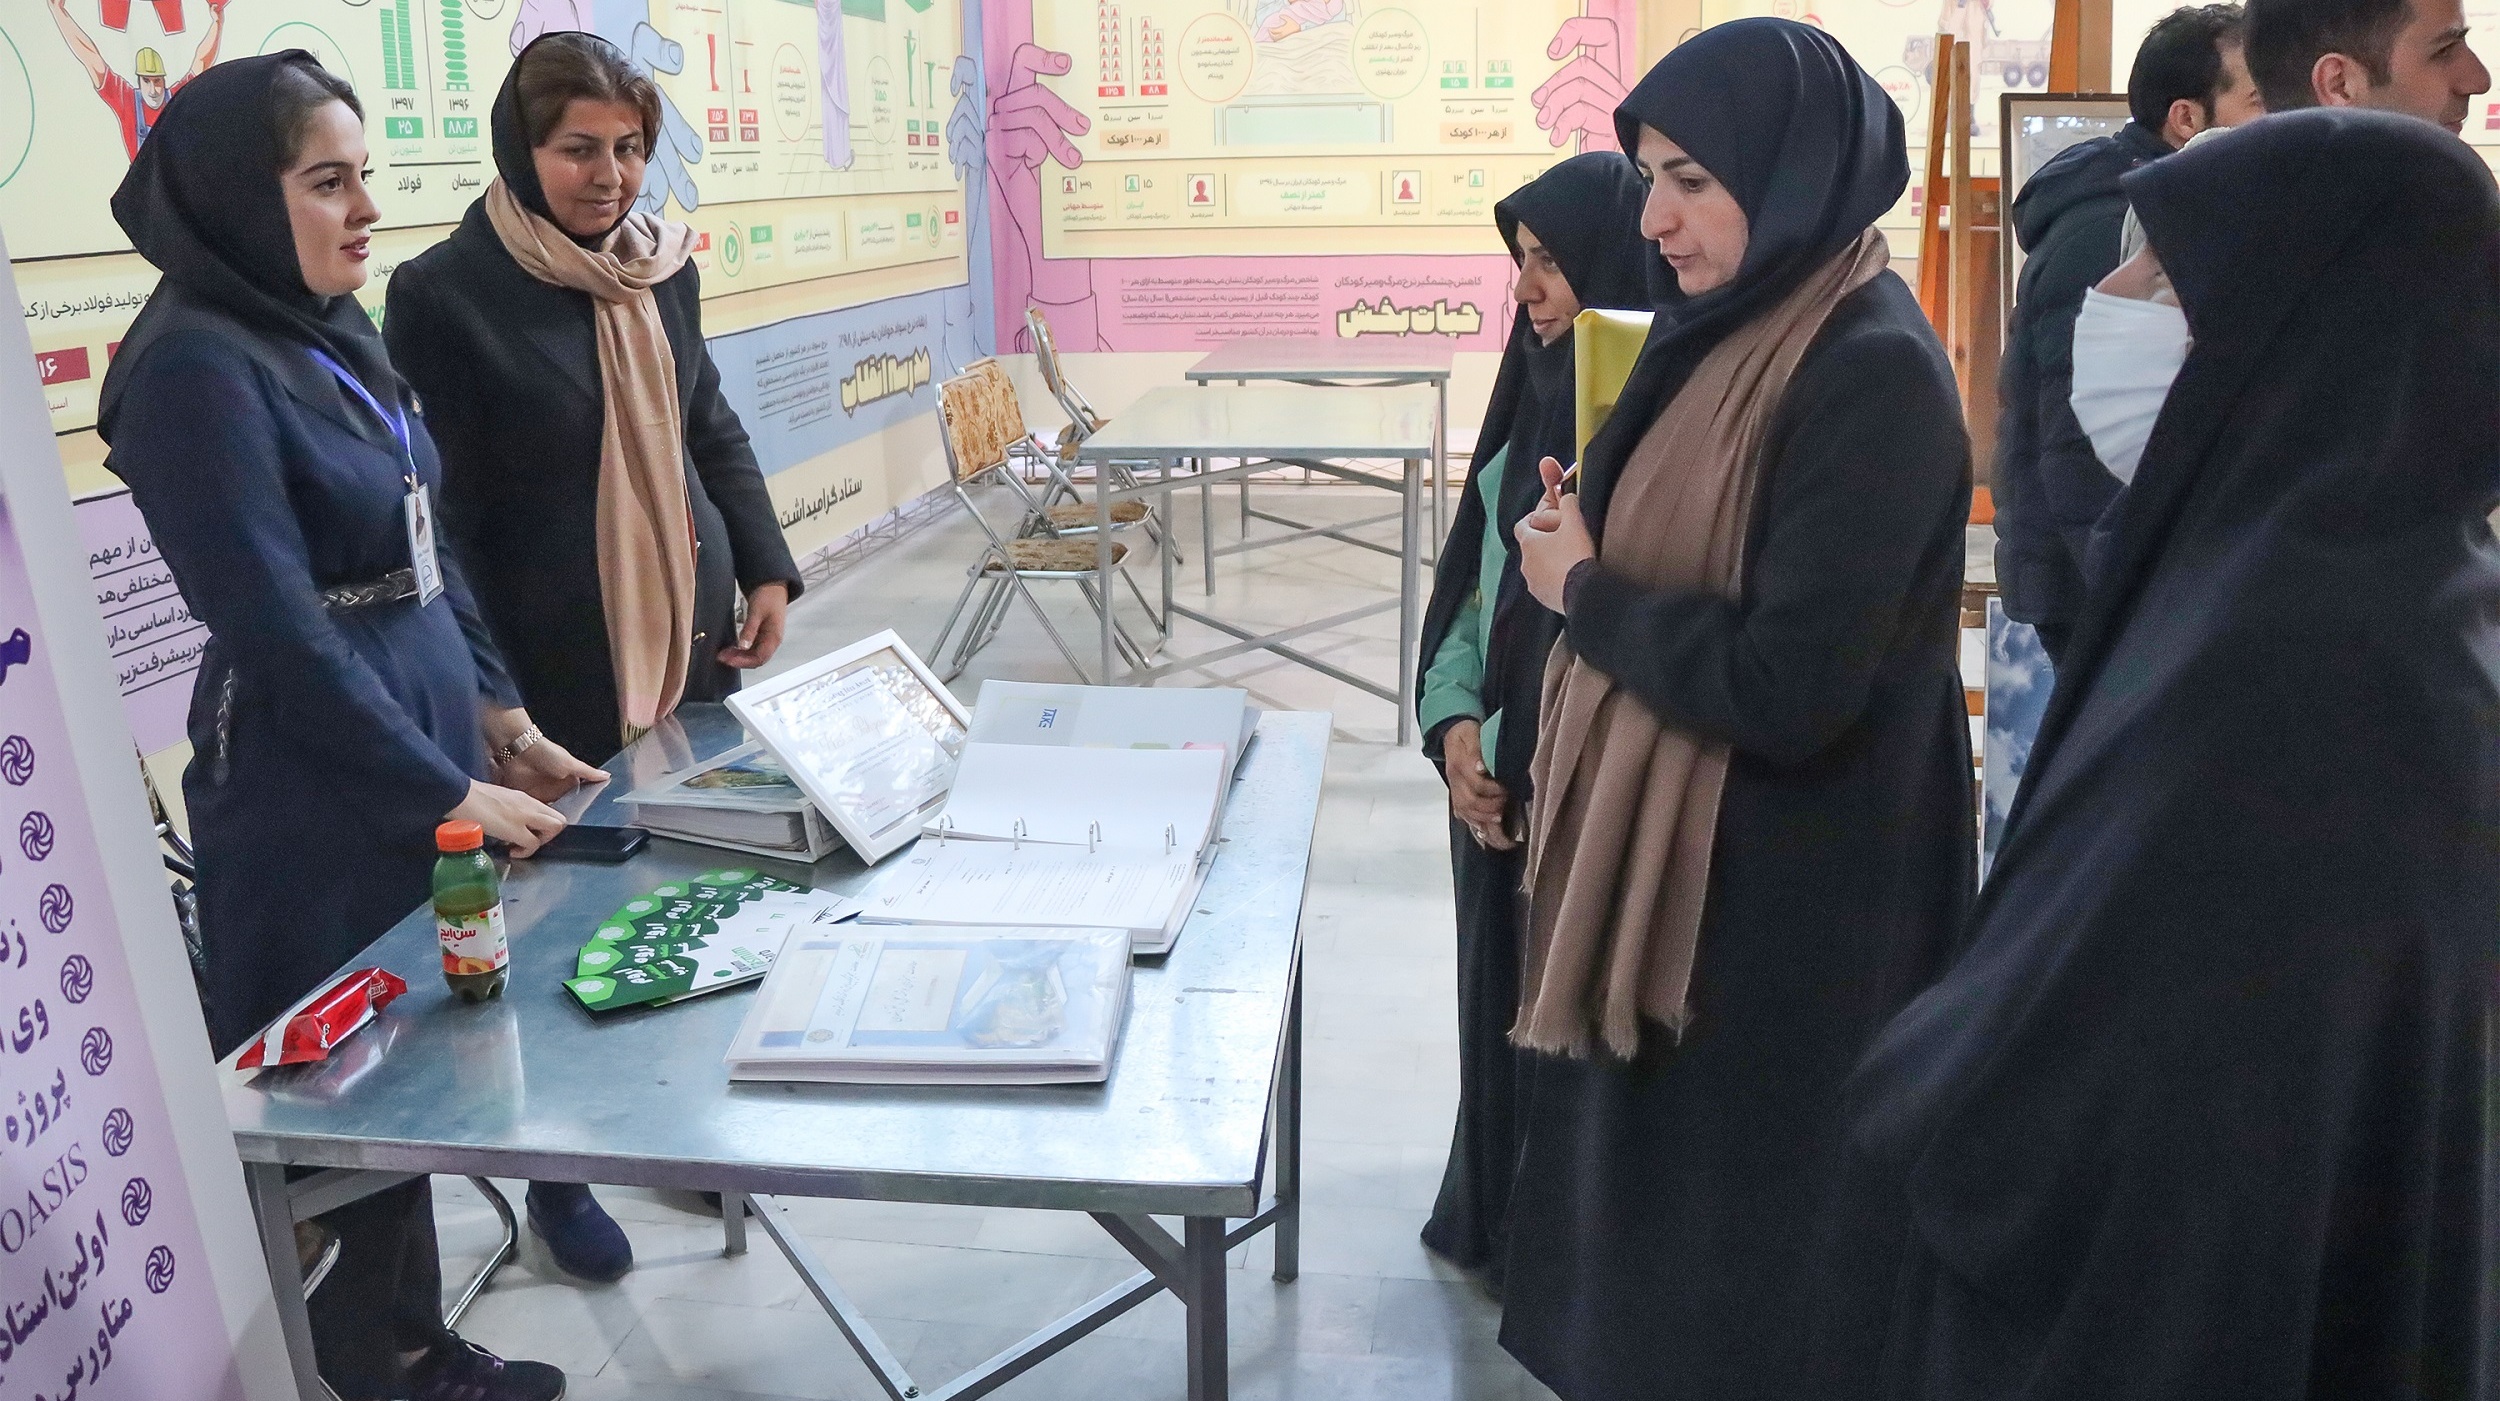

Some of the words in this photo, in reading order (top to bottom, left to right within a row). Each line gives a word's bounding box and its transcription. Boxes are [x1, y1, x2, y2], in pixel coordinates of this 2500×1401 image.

[1451, 79, 1460, 87] ۱۵
[1494, 79, 1505, 87] ۱۳
[1148, 86, 1160, 95] ۸۸
[391, 97, 414, 111] ۱۳۹۷
[449, 97, 470, 111] ۱۳۹۶
[1470, 108, 1485, 116] سن
[1128, 114, 1141, 123] سن
[398, 119, 413, 135] ۲۵
[1155, 133, 1162, 146] از
[1449, 127, 1473, 140] کودک
[1487, 129, 1500, 140] هر
[1501, 127, 1507, 140] از
[1107, 134, 1130, 146] کودک
[1143, 135, 1155, 146] هر
[390, 146, 400, 157] تن
[401, 144, 423, 156] میلیون
[448, 145, 458, 155] تن
[458, 143, 477, 155] میلیون
[398, 173, 422, 194] فولاد
[452, 174, 481, 191] سیمان
[1143, 178, 1153, 189] ۱۵
[1273, 178, 1285, 187] سال
[1453, 174, 1465, 184] ۱۳
[1079, 181, 1092, 190] ۳۹
[1280, 190, 1301, 200] نصف
[1308, 190, 1326, 202] کمتر
[1062, 203, 1081, 212] جهانی
[1081, 202, 1104, 211] متوسط
[1158, 277, 1182, 286] متوسط
[1226, 276, 1242, 286] نشان
[1242, 276, 1264, 285] کودکان
[1297, 276, 1319, 285] شاخص
[1334, 276, 1364, 288] کودکان
[1402, 277, 1416, 289] نرخ
[1417, 275, 1455, 288] چشمگیر
[1453, 275, 1483, 289] کاهش
[84, 293, 113, 313] فولاد
[115, 292, 143, 310] تولید
[1255, 293, 1269, 302] قبل
[1269, 293, 1289, 302] کودک
[40, 300, 50, 321] از
[51, 301, 82, 319] برخی
[1213, 311, 1229, 320] کمتر
[1229, 311, 1253, 320] شاخص
[1240, 327, 1259, 338] کشور
[1272, 328, 1290, 337] درمان
[840, 351, 888, 420] انقلاب
[838, 478, 863, 502] ستاد
[780, 483, 839, 530] گرامیداشت
[126, 536, 136, 560] از
[117, 573, 173, 603] مختلفی
[128, 606, 176, 641] اساسی
[135, 648, 191, 675] پیشرفت
[12, 997, 50, 1055] وی
[5, 1066, 71, 1149] پروژه
[0, 1140, 88, 1254] OASIS
[59, 1208, 109, 1311] اولین
